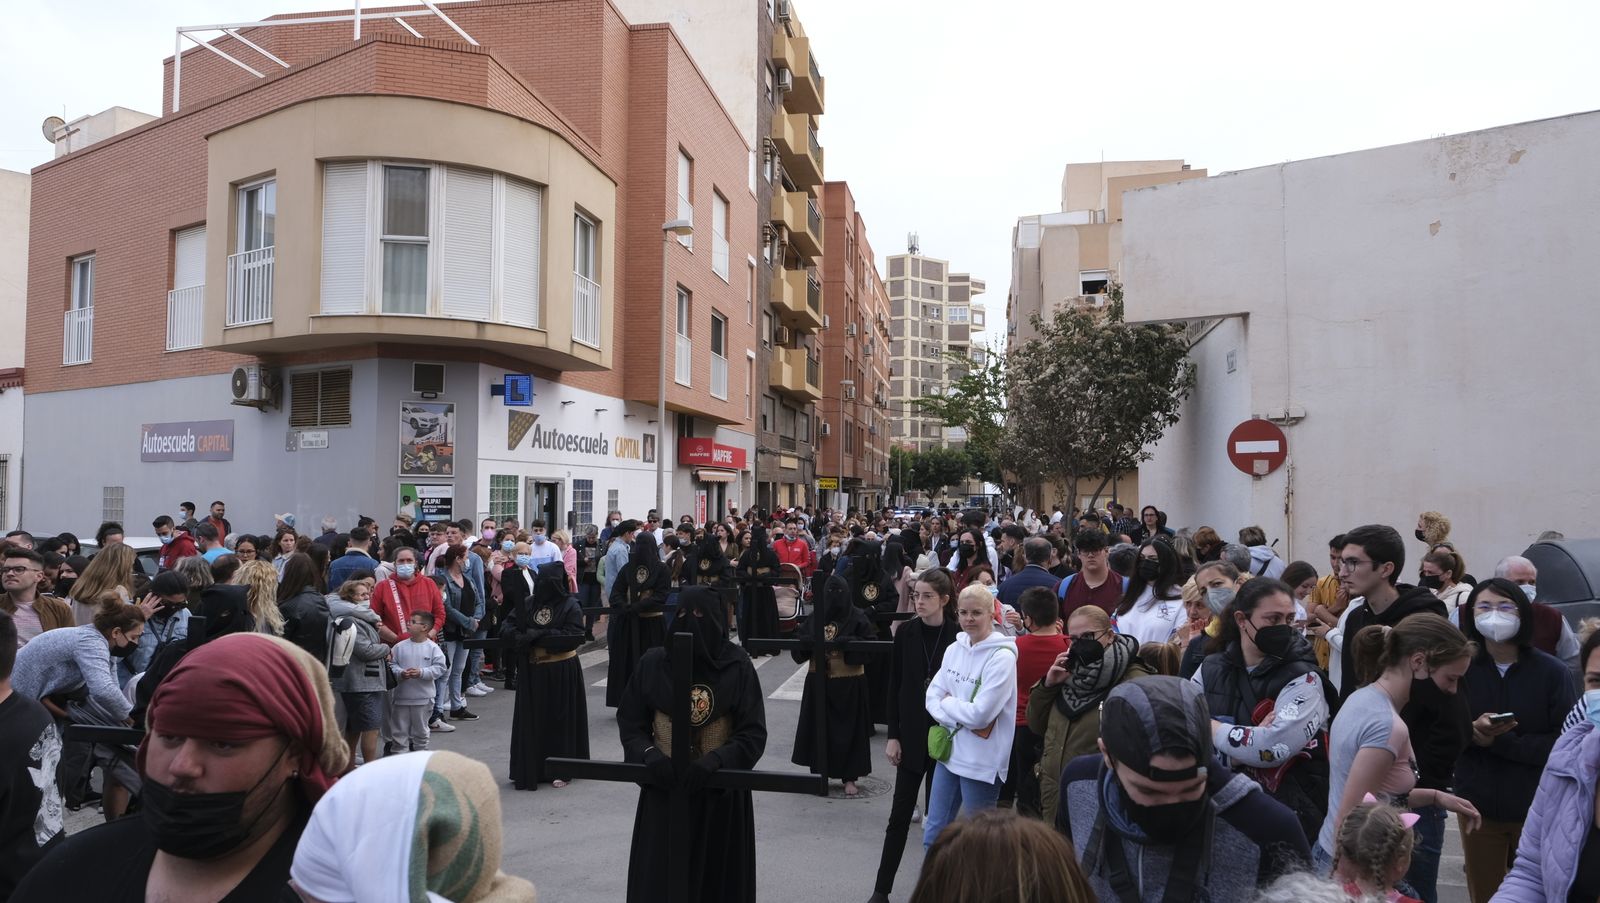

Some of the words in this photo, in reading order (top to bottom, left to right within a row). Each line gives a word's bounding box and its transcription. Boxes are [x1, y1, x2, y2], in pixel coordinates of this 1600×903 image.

[510, 378, 525, 402] L
[142, 428, 195, 454] Autoescuela
[197, 434, 231, 453] CAPITAL
[531, 423, 609, 456] Autoescuela
[614, 435, 641, 460] CAPITAL
[712, 449, 733, 464] MAPFRE
